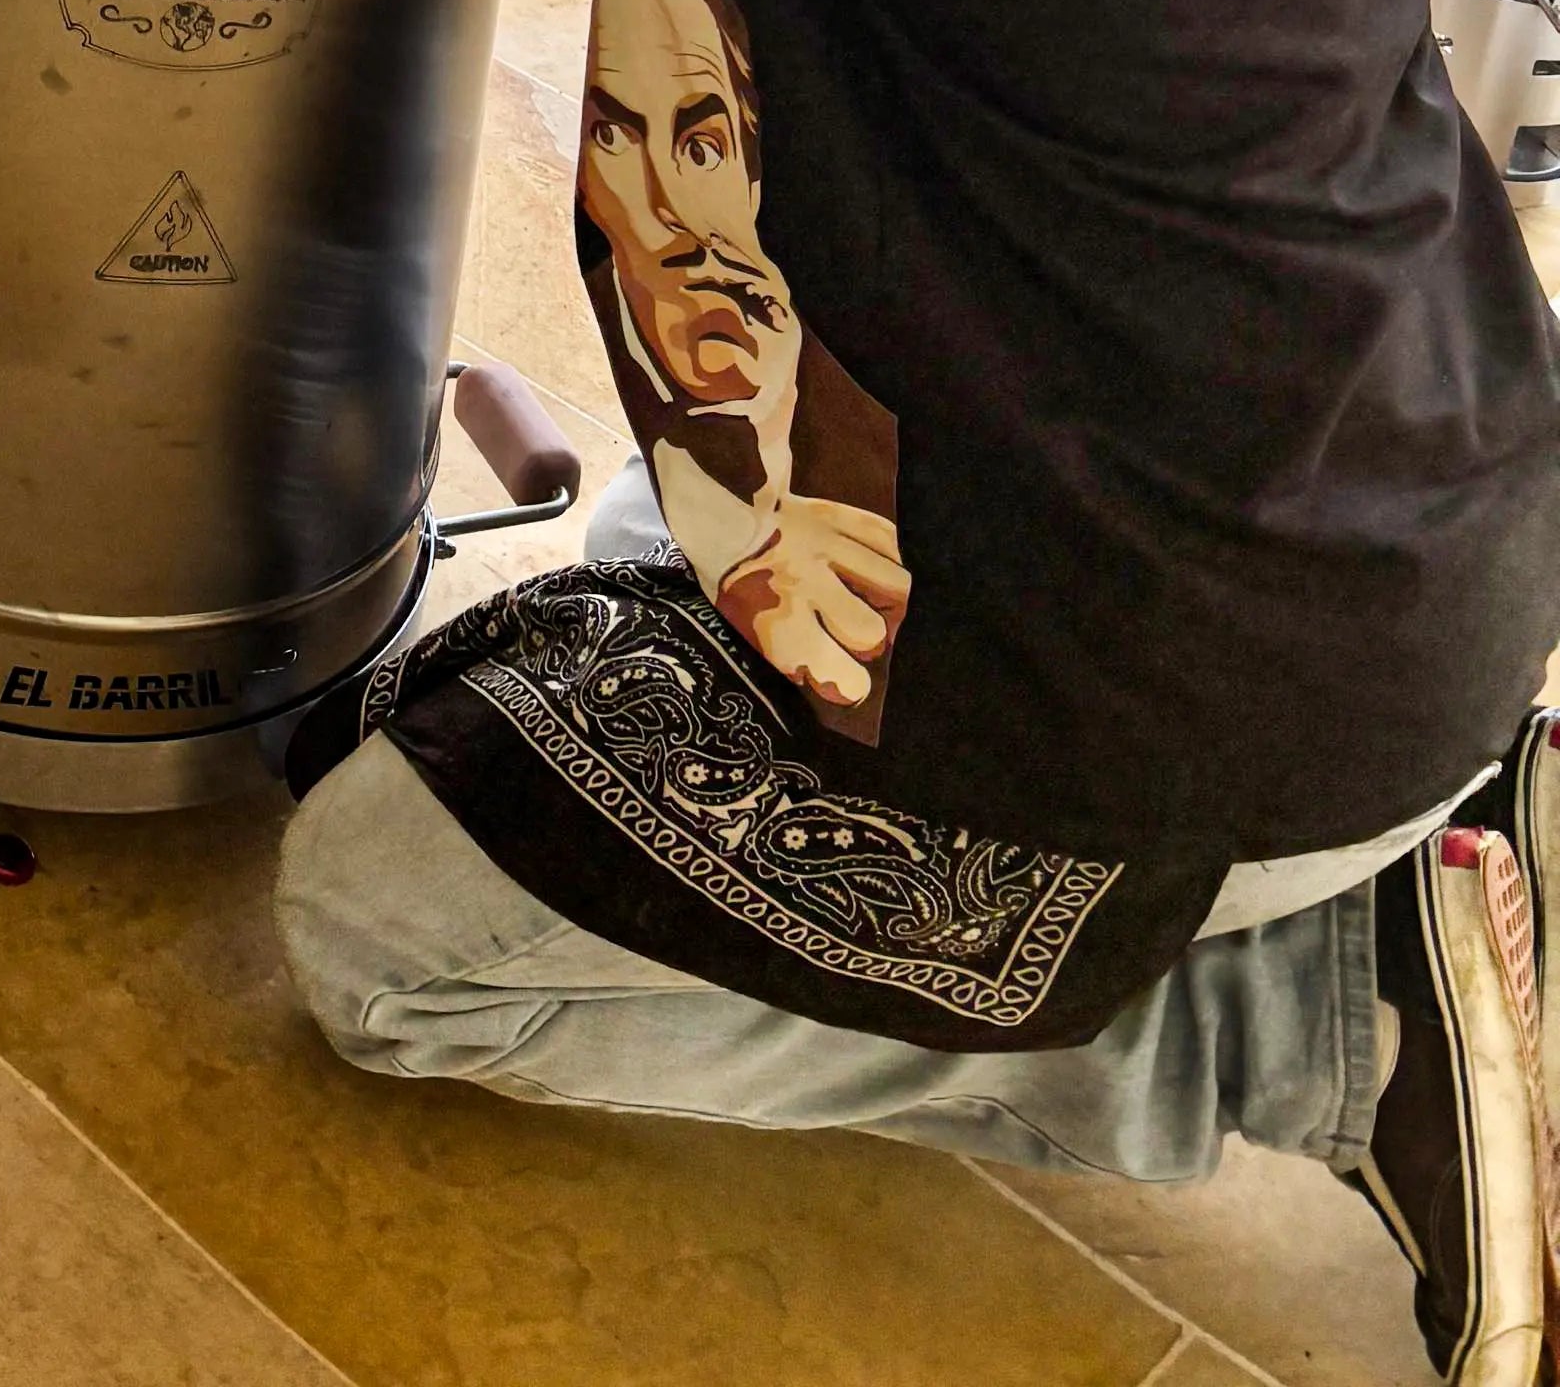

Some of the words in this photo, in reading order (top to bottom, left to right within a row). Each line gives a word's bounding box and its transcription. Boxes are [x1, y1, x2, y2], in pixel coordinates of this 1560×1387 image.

[129, 254, 210, 274] CAUTION
[0, 665, 52, 708] EL
[68, 668, 233, 711] BARRIL
